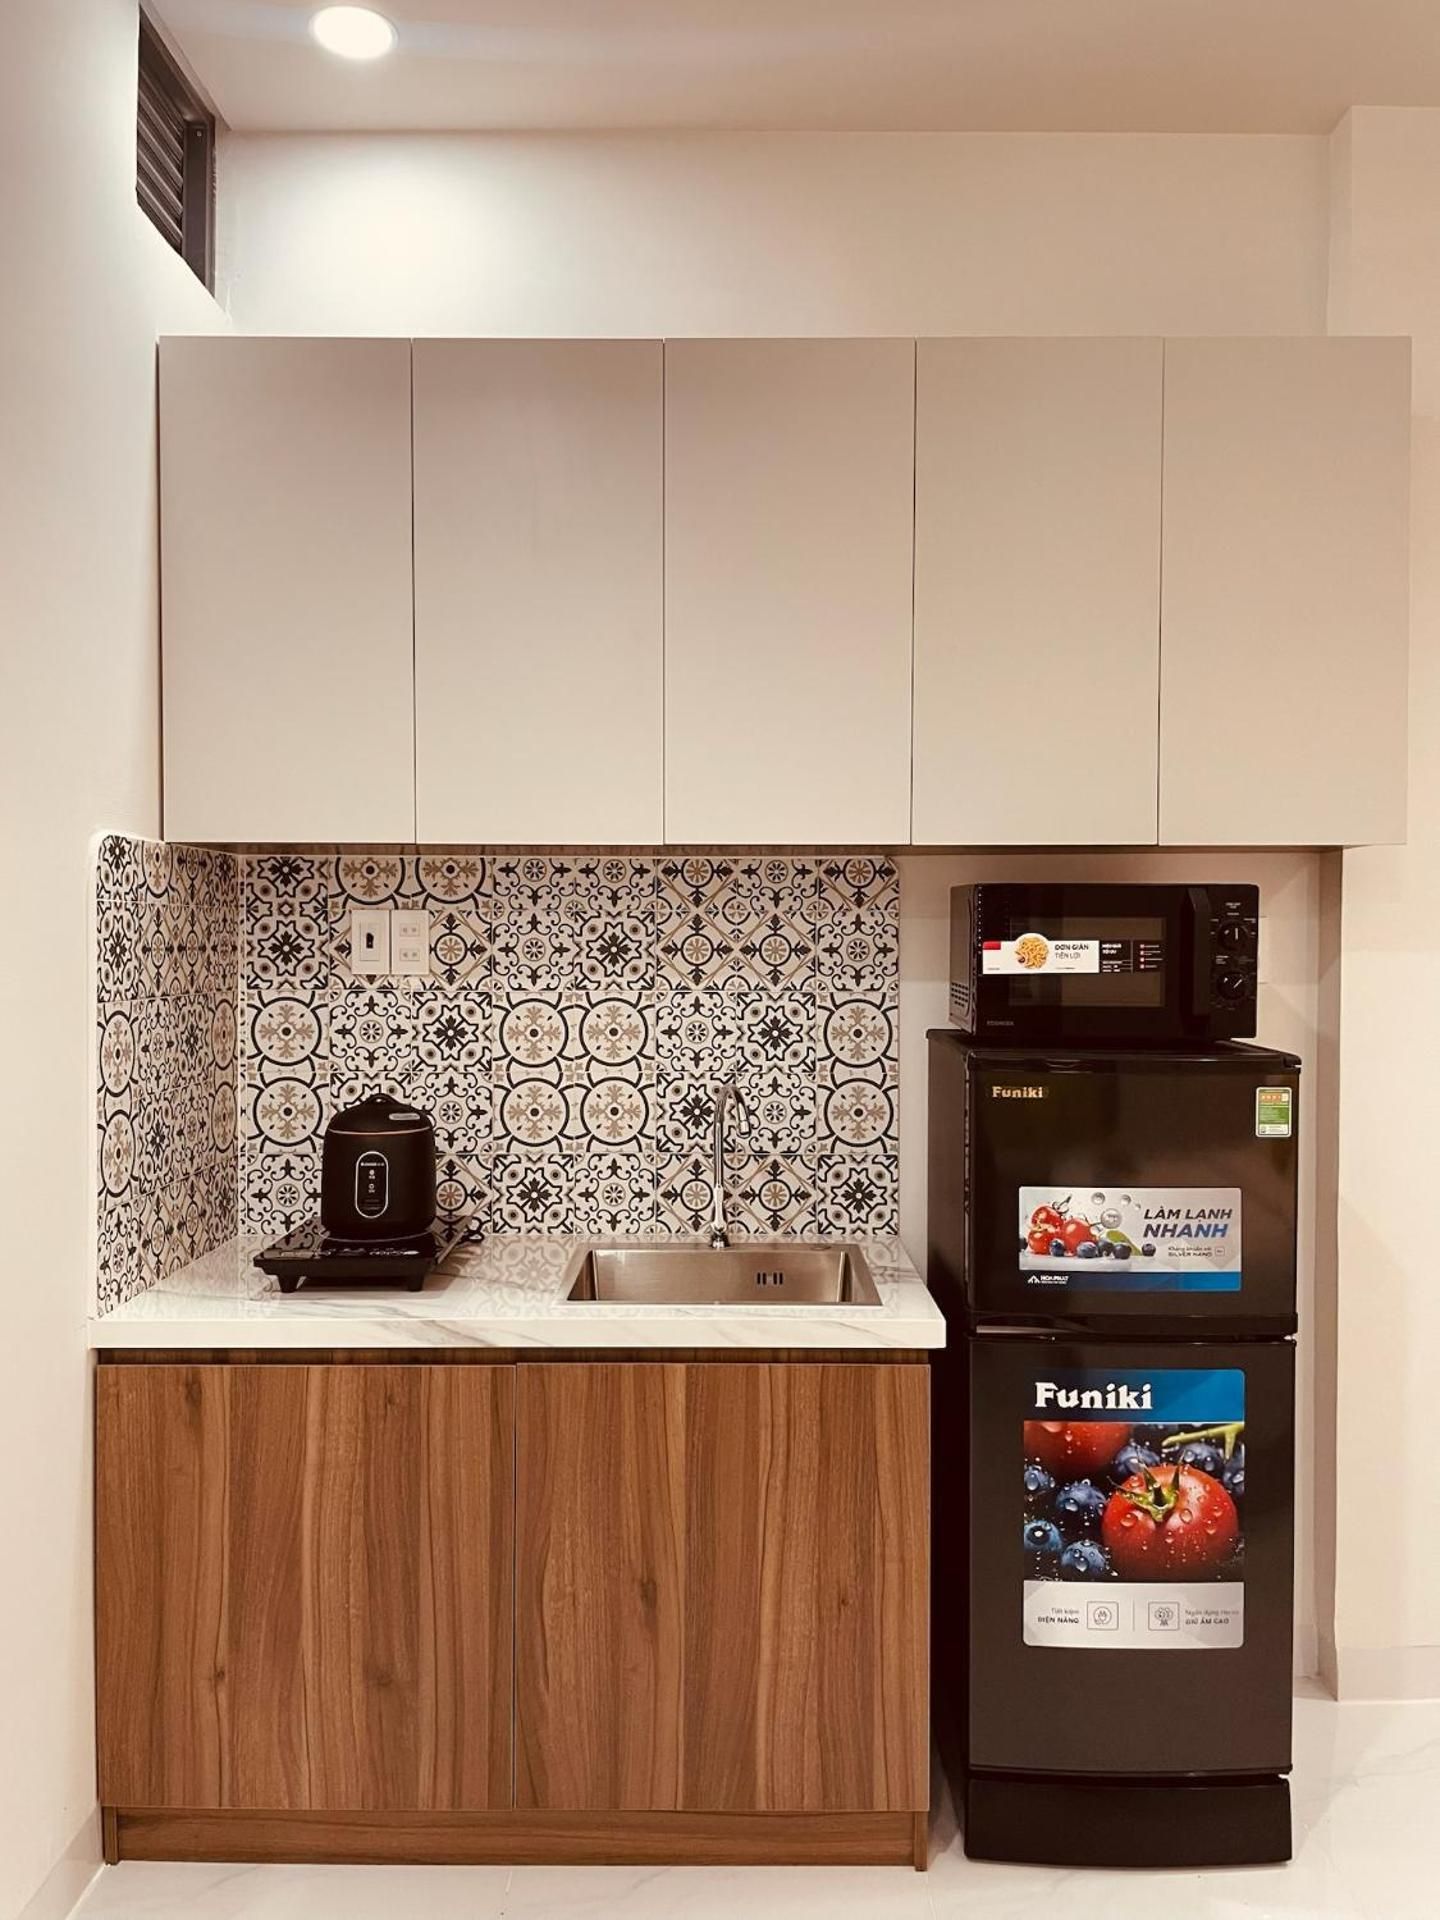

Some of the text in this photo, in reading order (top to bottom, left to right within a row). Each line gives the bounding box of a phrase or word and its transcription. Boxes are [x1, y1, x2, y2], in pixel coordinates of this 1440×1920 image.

[992, 1086, 1043, 1098] Funiki
[1143, 1205, 1233, 1222] LÀM LẠNH
[1143, 1223, 1229, 1238] NHANH
[1034, 1381, 1153, 1410] Funiki
